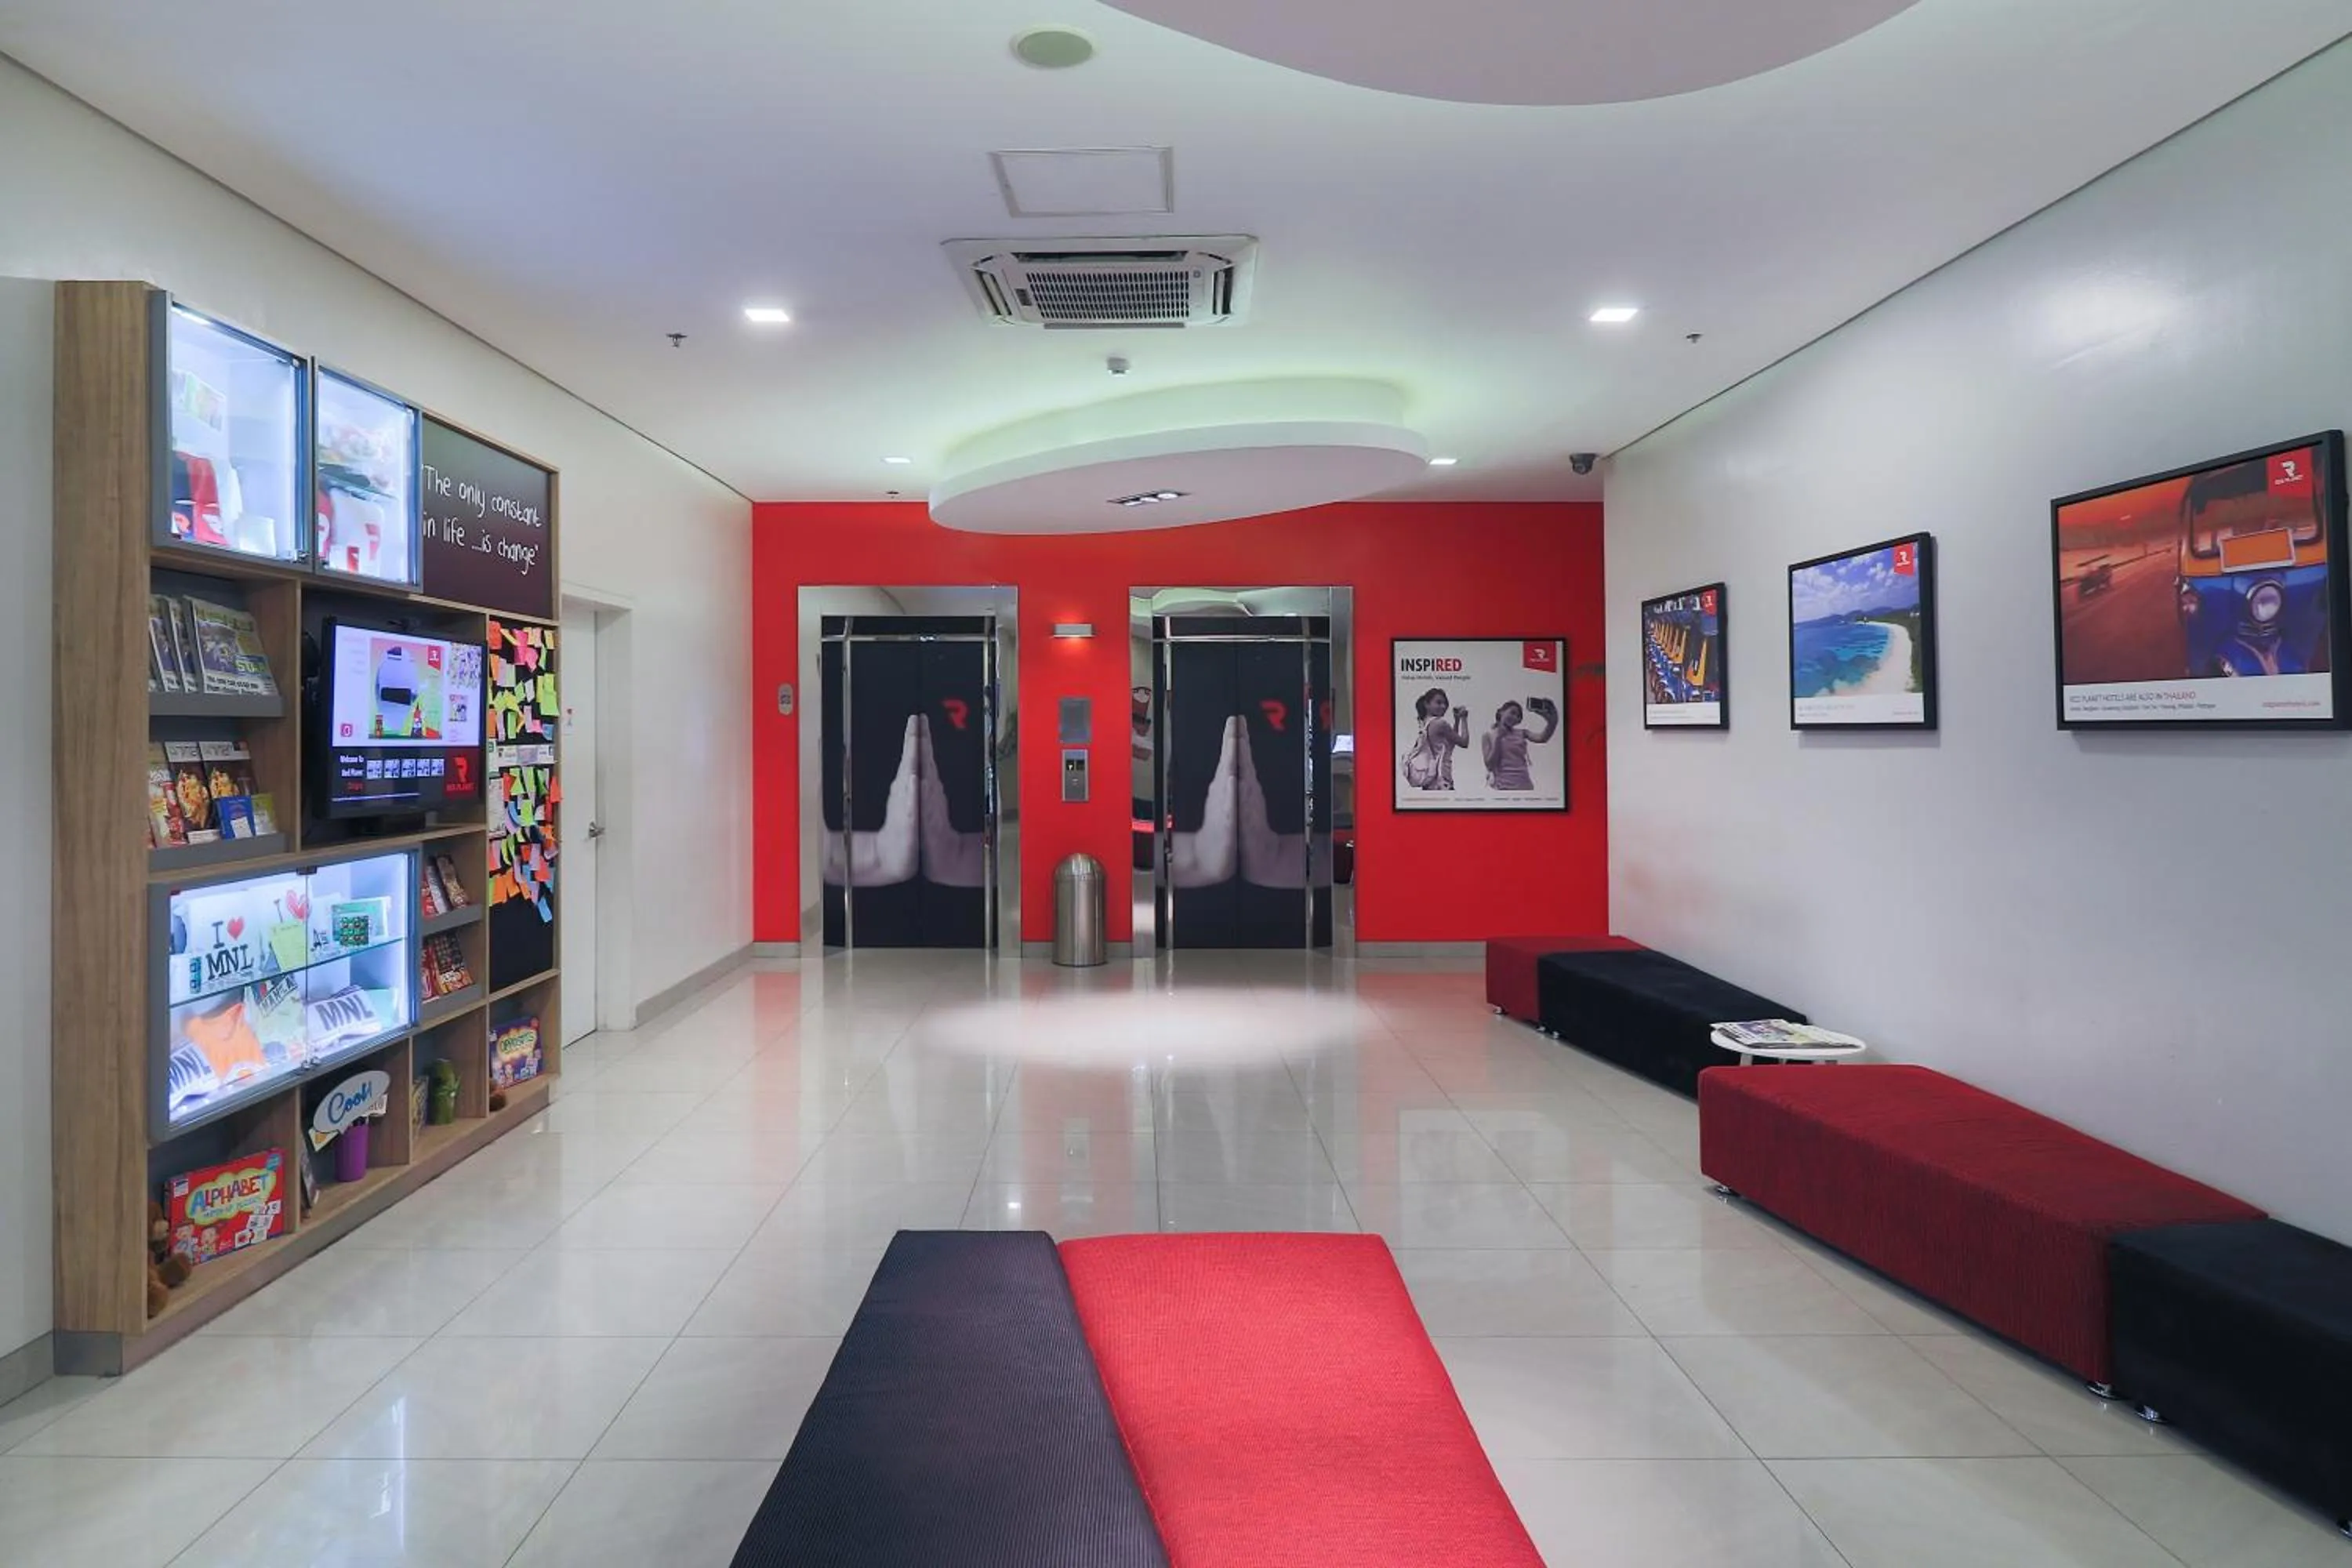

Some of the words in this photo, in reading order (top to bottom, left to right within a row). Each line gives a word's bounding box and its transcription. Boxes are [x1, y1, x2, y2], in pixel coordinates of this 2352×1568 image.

[459, 481, 485, 517] only
[491, 495, 542, 527] constant
[423, 511, 436, 539] in
[443, 517, 465, 546] life
[1401, 658, 1462, 672] INSPIRED
[205, 944, 255, 981] MNL
[315, 995, 374, 1031] MNL
[189, 1173, 270, 1217] ALPHABET
